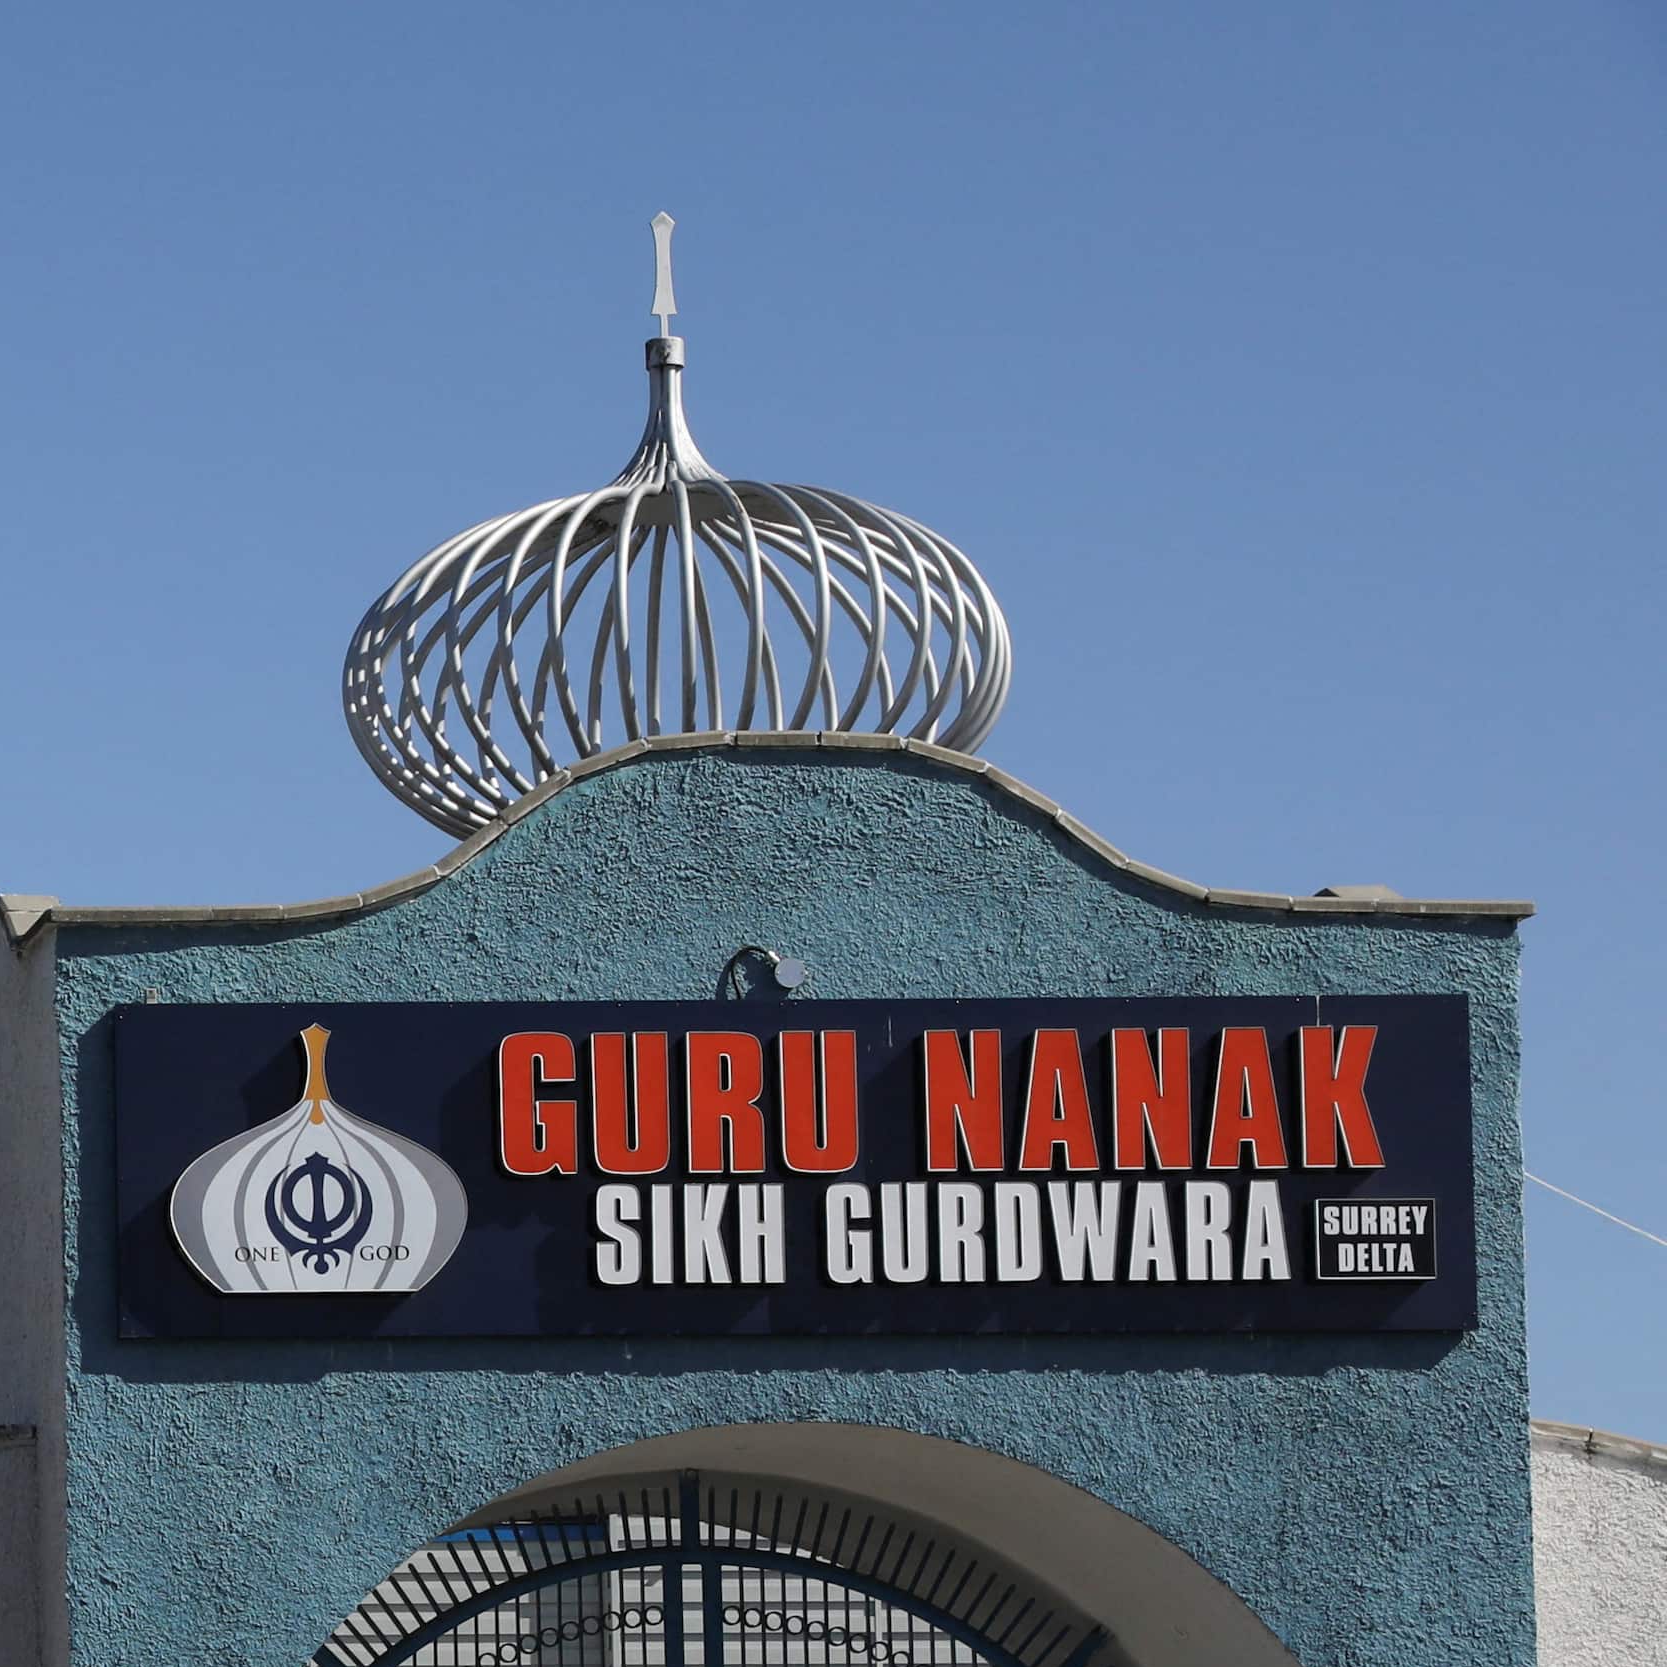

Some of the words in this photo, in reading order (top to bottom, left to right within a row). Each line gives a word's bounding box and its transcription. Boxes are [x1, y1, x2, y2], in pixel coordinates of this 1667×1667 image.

[499, 1030, 859, 1176] GURU
[925, 1026, 1385, 1171] NANAK
[596, 1183, 786, 1286] SIKH
[825, 1179, 1292, 1284] GURDWARA
[1323, 1206, 1428, 1236] SURREY
[234, 1246, 280, 1262] ONE
[359, 1245, 411, 1261] GOD
[1338, 1243, 1416, 1273] DELTA
